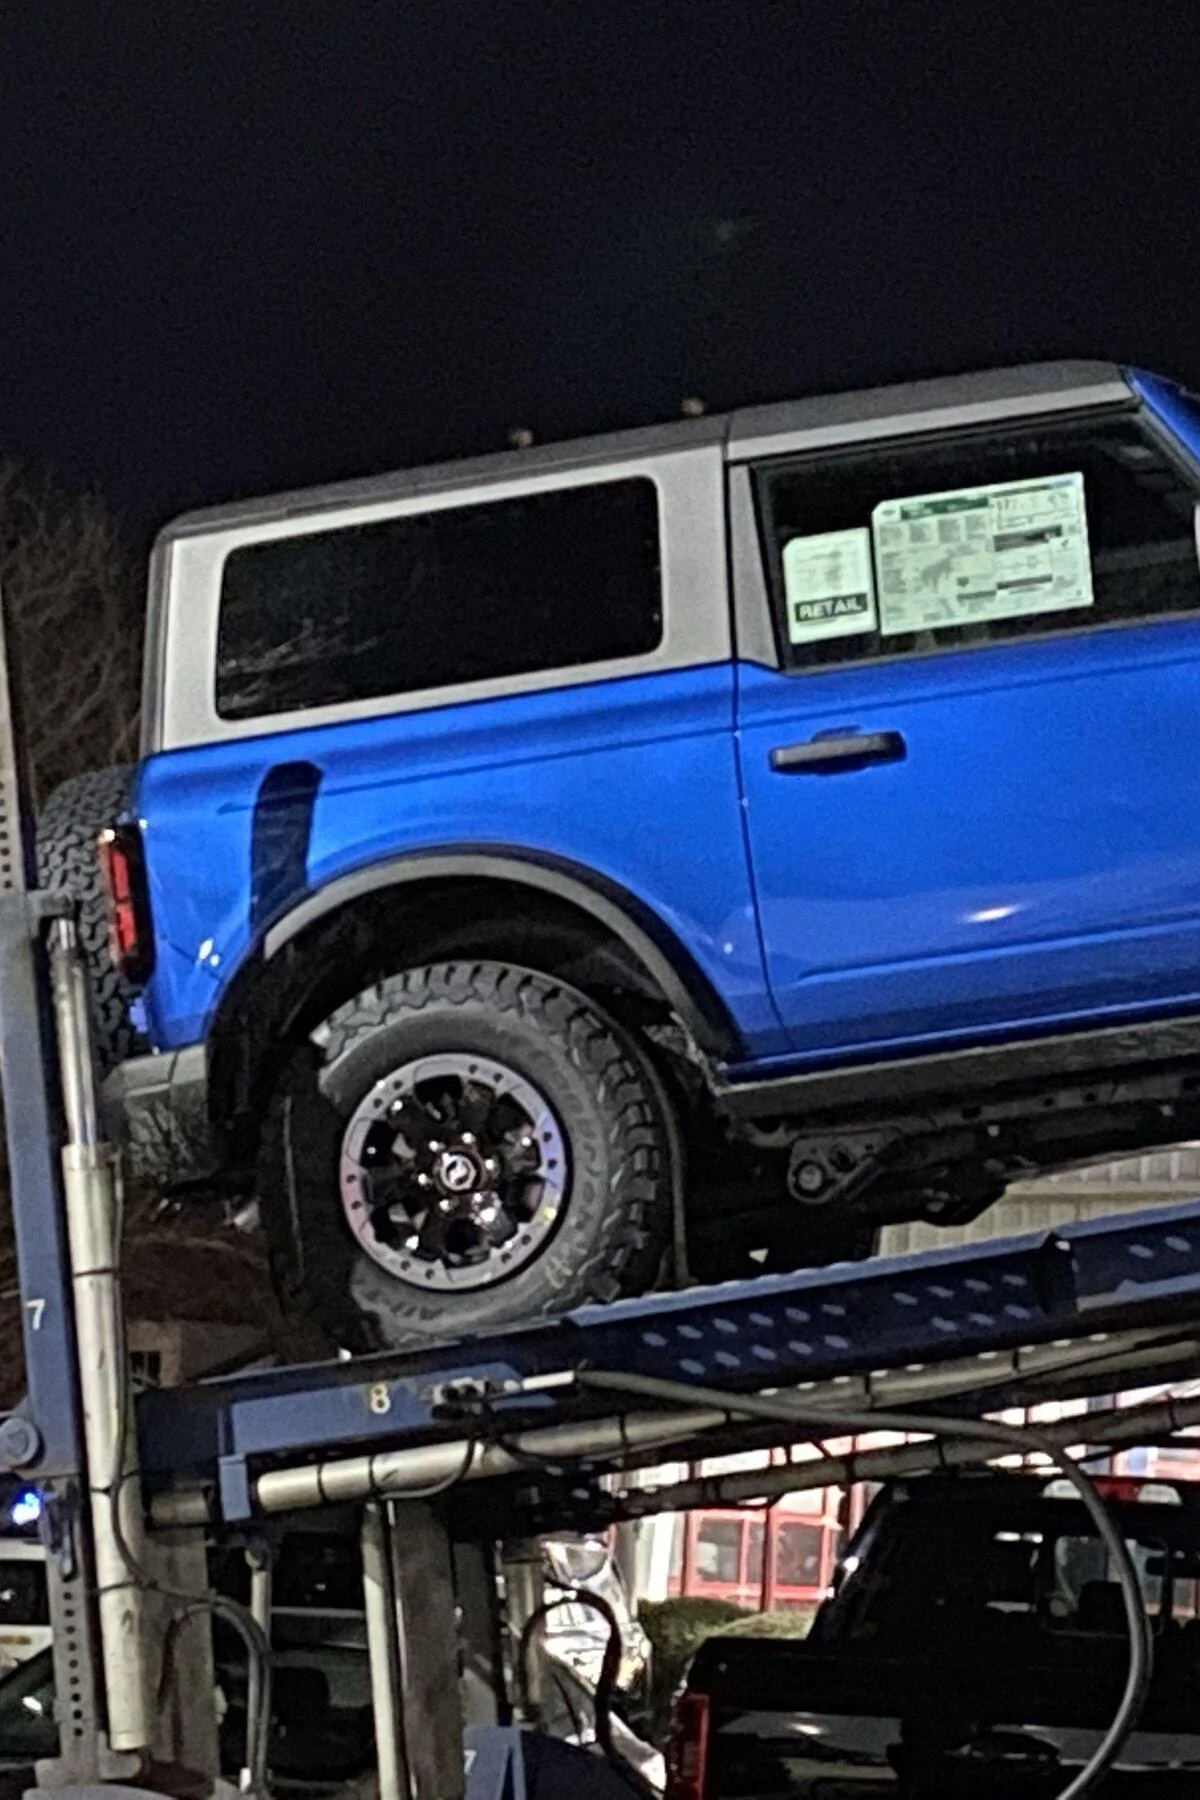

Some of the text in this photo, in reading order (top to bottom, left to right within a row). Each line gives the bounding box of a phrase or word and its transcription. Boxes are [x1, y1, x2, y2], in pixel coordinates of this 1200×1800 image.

[799, 597, 863, 619] RETAIL
[25, 1299, 46, 1330] 7
[370, 1382, 391, 1414] 8
[464, 1750, 477, 1776] 7
